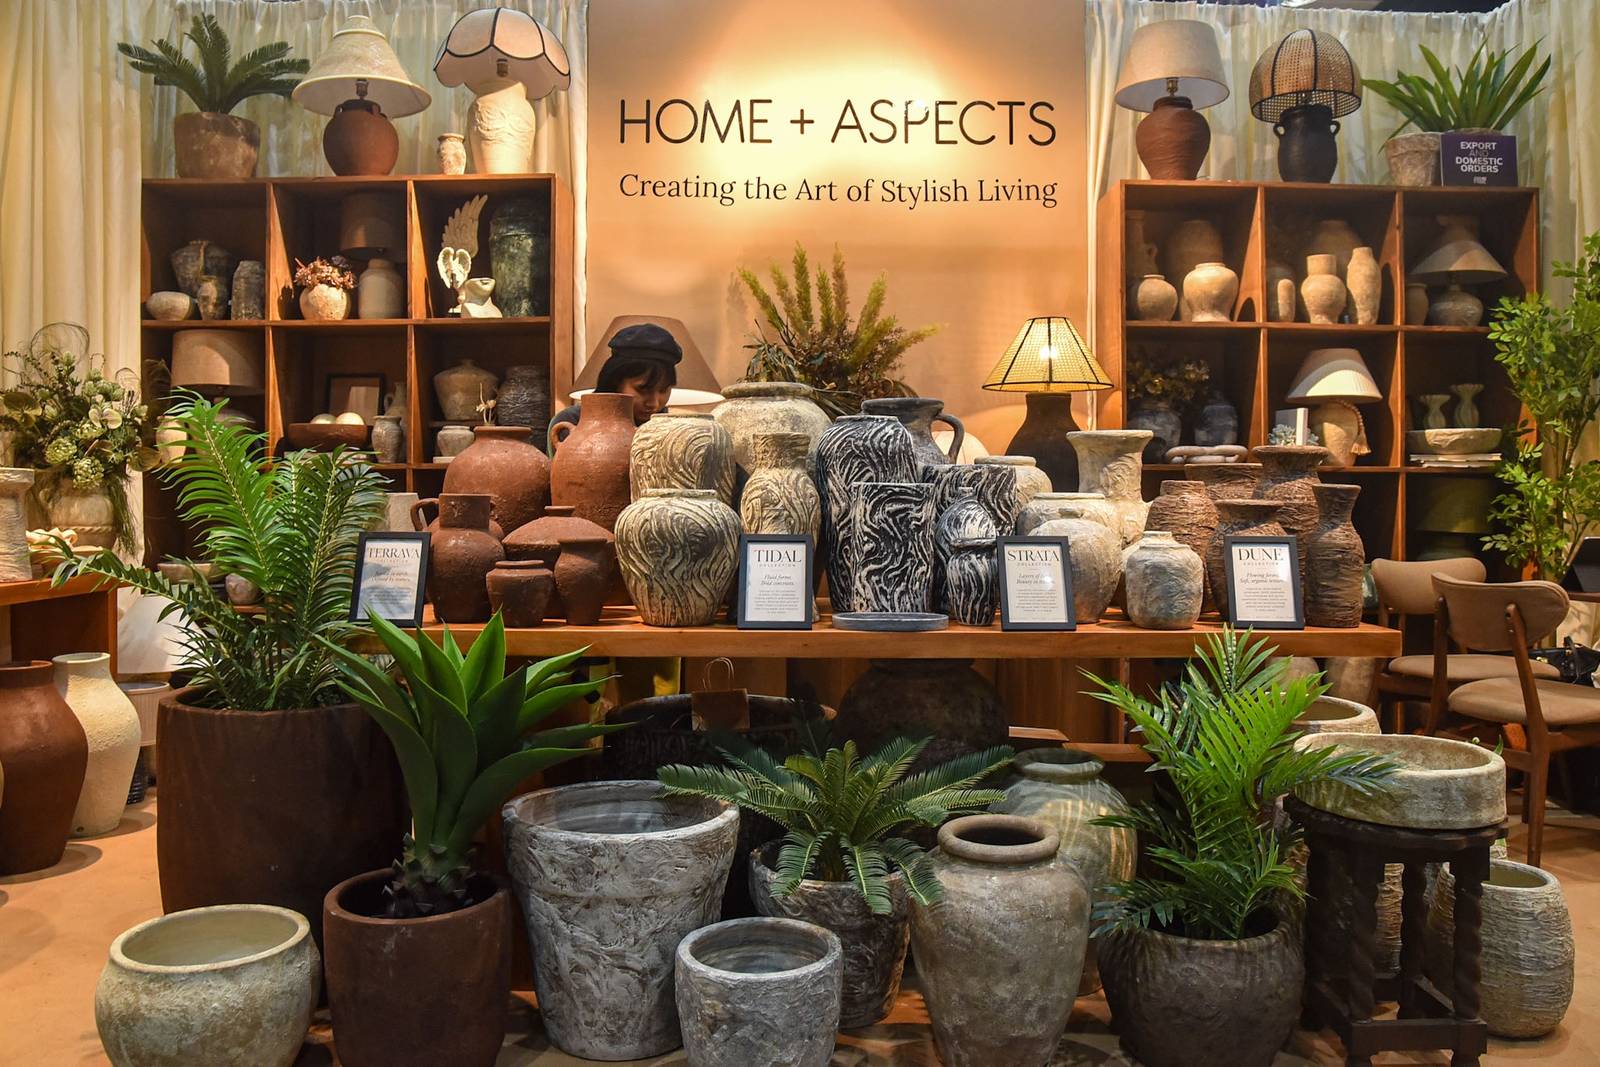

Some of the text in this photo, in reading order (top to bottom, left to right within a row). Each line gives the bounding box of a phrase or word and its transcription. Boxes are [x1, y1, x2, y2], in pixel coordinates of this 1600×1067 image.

[619, 98, 1057, 146] HOME + ASPECTS
[1460, 141, 1497, 150] EXPORT
[1469, 149, 1489, 157] AND
[1455, 156, 1504, 166] DOMESTIC
[1460, 164, 1499, 173] ORDERS
[619, 173, 1058, 210] Creating the Art of Stylish Living
[368, 547, 420, 559] TERRAVA
[754, 549, 802, 563] TIDAL
[1007, 549, 1060, 562] STRATA
[1238, 548, 1284, 561] DUNE
